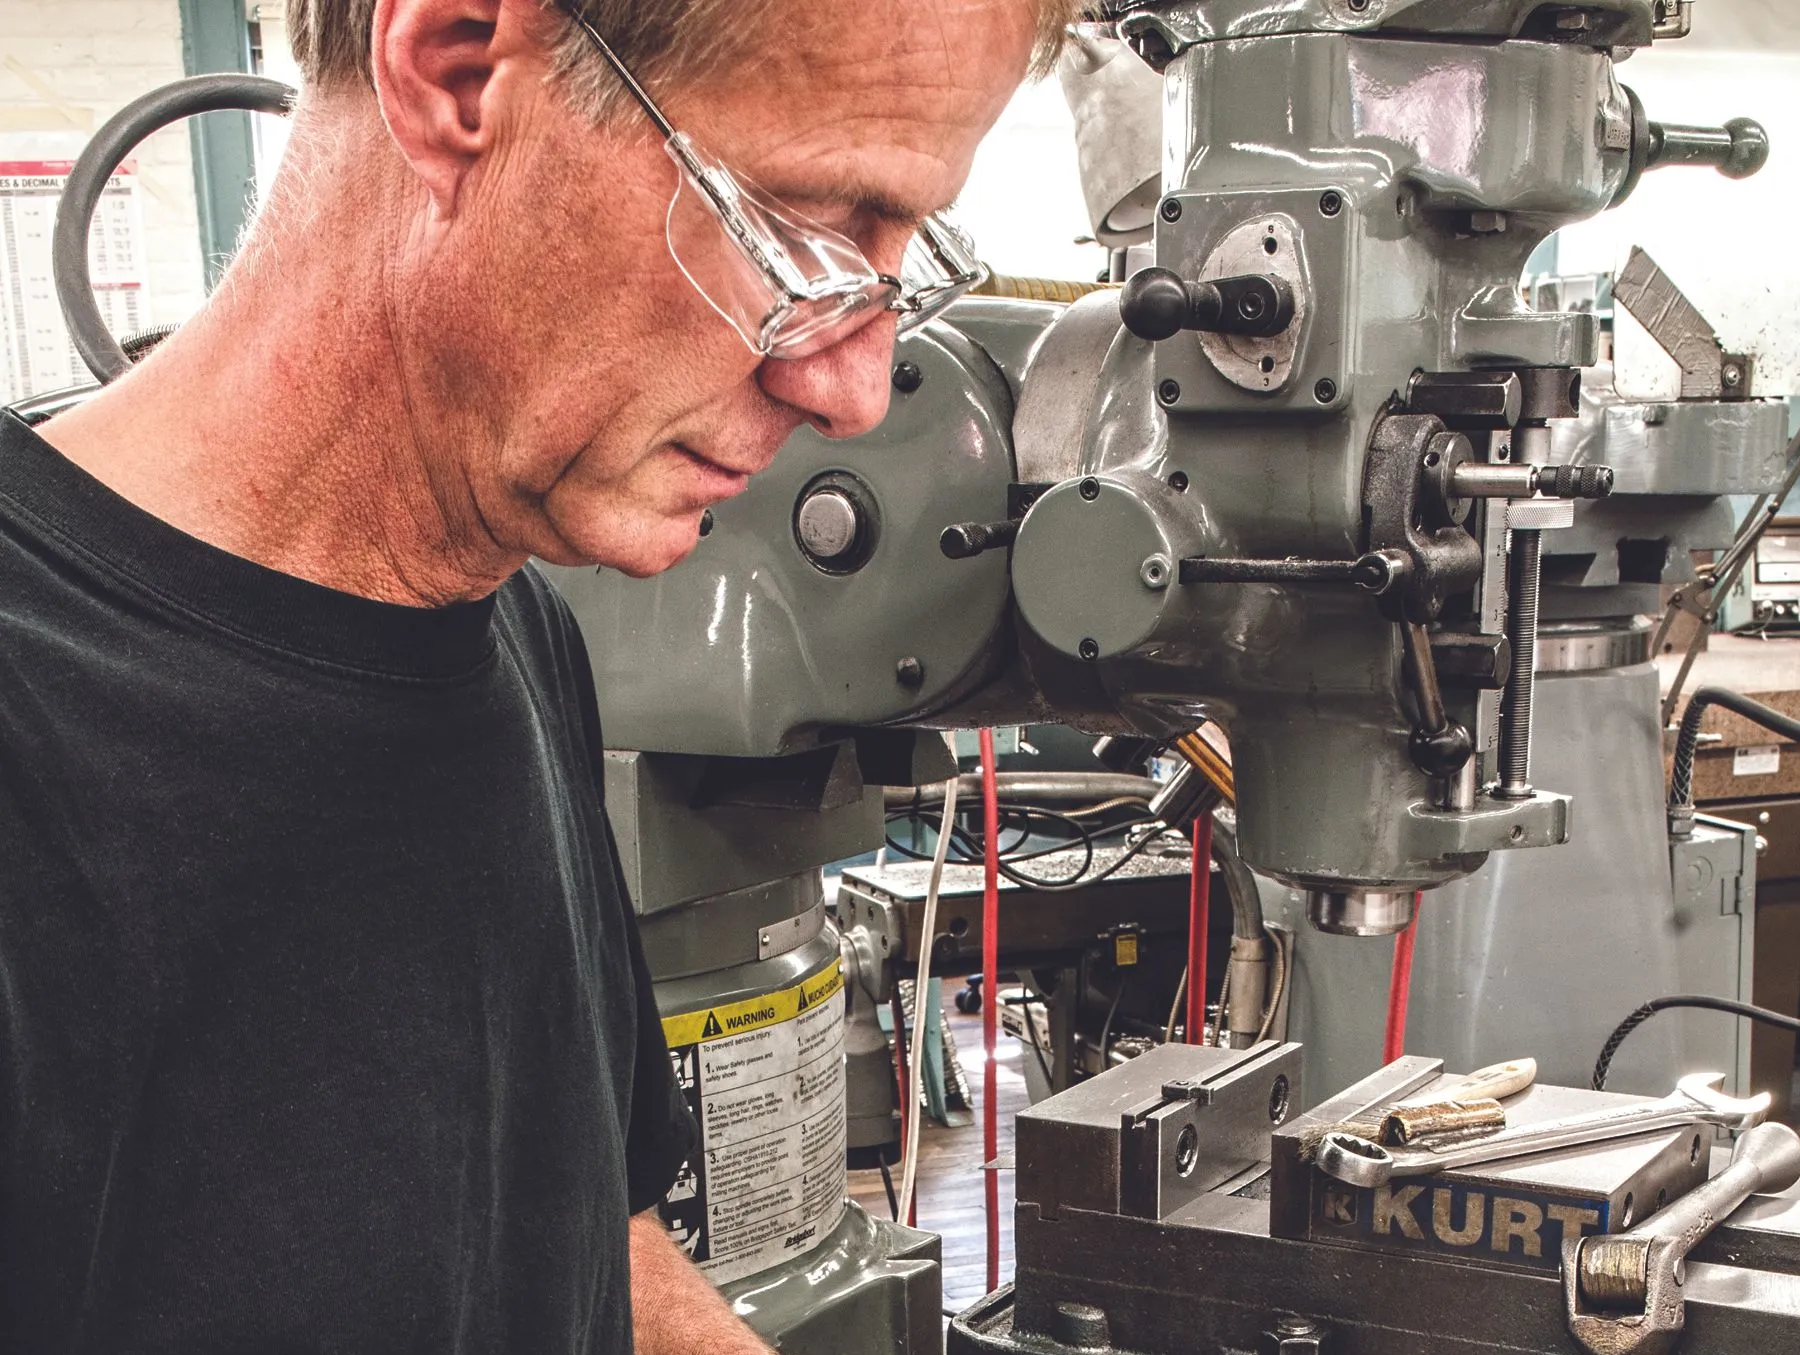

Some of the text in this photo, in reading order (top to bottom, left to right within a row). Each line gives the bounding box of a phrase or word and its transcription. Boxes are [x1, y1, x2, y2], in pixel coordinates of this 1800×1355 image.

[22, 178, 60, 188] DECIMAL
[1268, 225, 1274, 234] 6
[1264, 378, 1270, 387] 3
[726, 1007, 775, 1030] WARNING
[703, 1045, 711, 1053] To
[712, 1040, 734, 1052] prevent
[736, 1035, 756, 1045] serious
[705, 1062, 715, 1074] 1.
[716, 1064, 730, 1072] Wear
[731, 1059, 746, 1069] Safety
[707, 1103, 717, 1115] 2.
[710, 1153, 720, 1164] 3.
[713, 1206, 722, 1217] 4.
[1372, 1184, 1600, 1258] KURT
